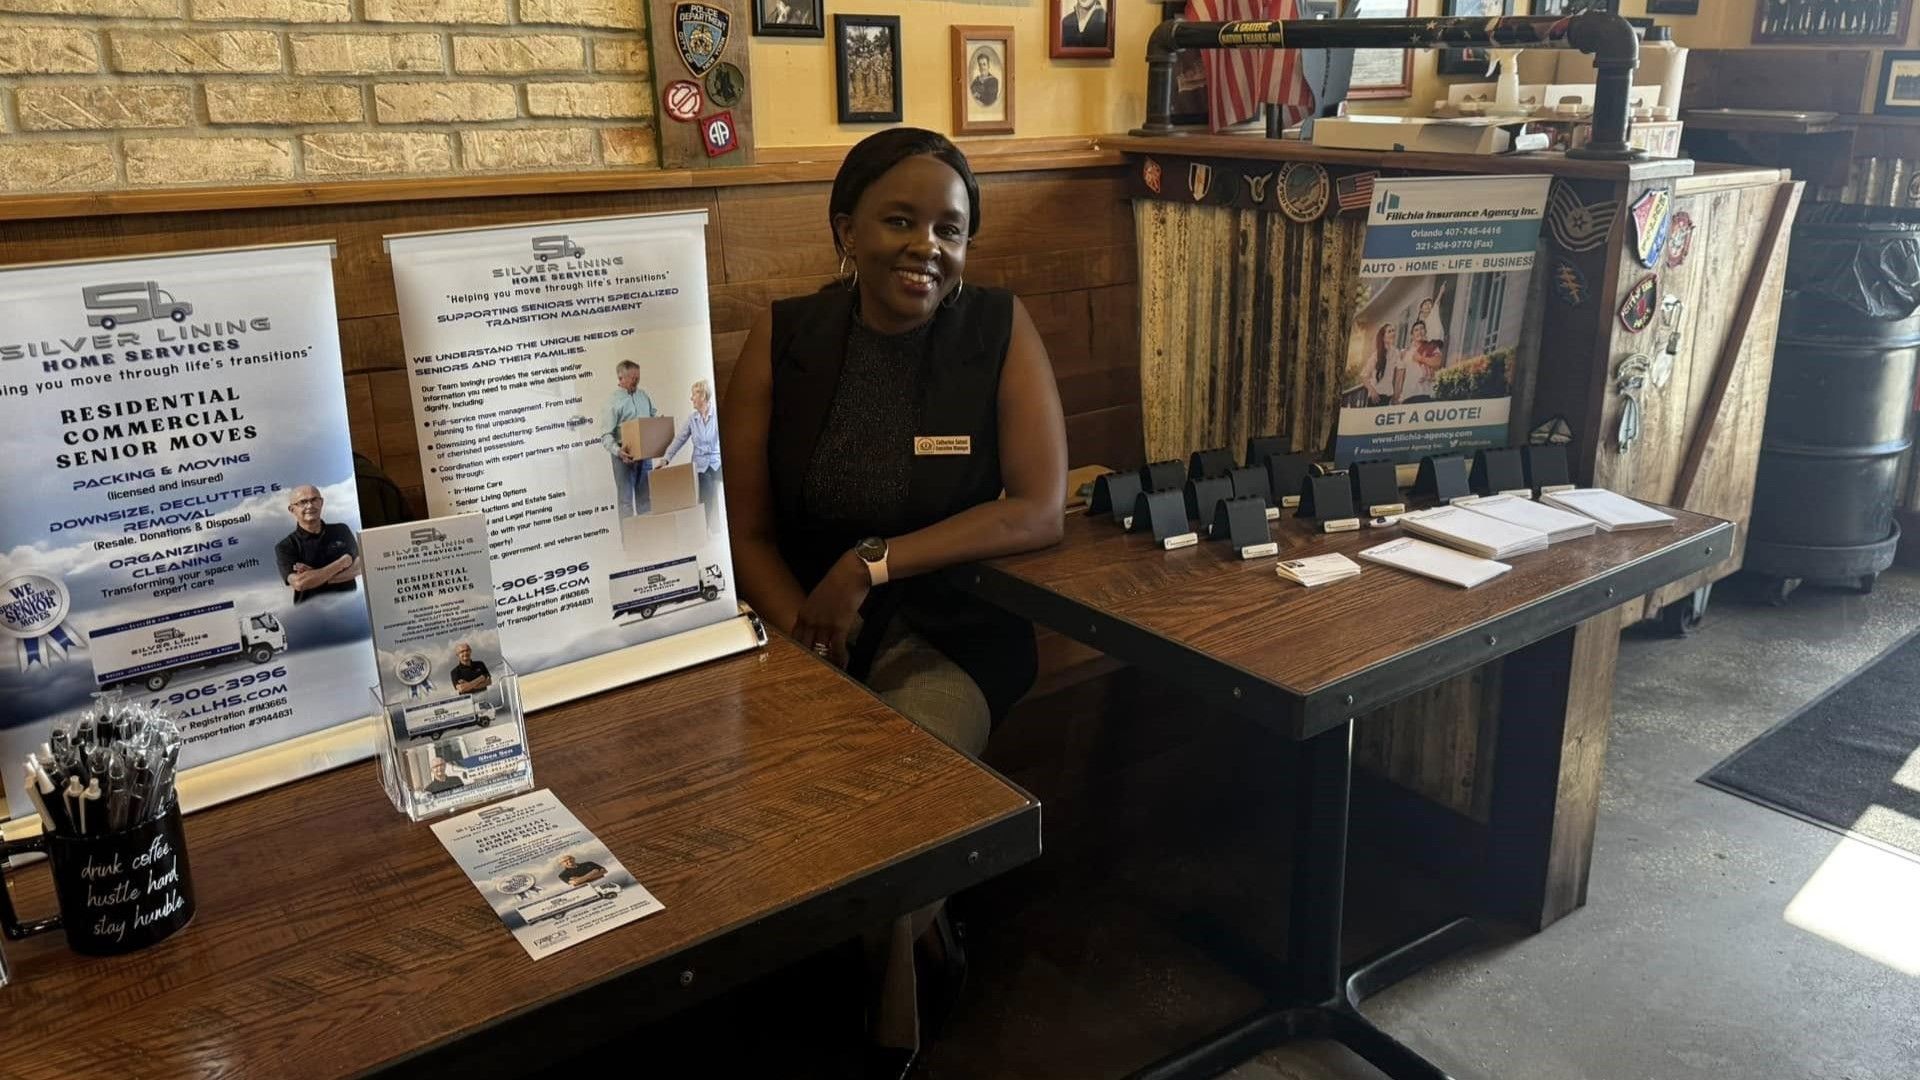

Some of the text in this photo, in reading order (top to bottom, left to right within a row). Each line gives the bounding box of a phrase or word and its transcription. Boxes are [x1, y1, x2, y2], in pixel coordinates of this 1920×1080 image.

[680, 11, 728, 30] DEPARTMENT
[690, 4, 719, 18] POLICE
[1426, 209, 1480, 221] Insurance
[1480, 207, 1520, 220] Agency
[1520, 207, 1539, 216] Inc.
[1410, 228, 1444, 239] Orlando
[492, 255, 625, 278] SILVER LINING
[511, 267, 608, 286] HOME SERVICES
[1362, 256, 1536, 275] AUTO HOME LIFE BUSINESS
[493, 290, 512, 301] you
[514, 286, 542, 296] move
[545, 279, 584, 293] through
[437, 286, 680, 323] SUPPORTING SENIORS WITH SPECIALIZED
[485, 302, 644, 328] TRANSITION MANAGEMENT
[0, 316, 272, 361] SILVER LINING
[413, 327, 636, 365] WE UNDERSTAND THE UNIQUE NEEDS OF
[41, 338, 241, 374] HOME SERVICES
[415, 364, 469, 377] SENIORS
[472, 358, 497, 369] AND
[499, 353, 533, 364] THEIR
[36, 379, 63, 394] you
[70, 373, 113, 387] move
[118, 362, 180, 382] through
[185, 356, 225, 374] life's
[421, 385, 436, 393] Our
[438, 383, 459, 391] Team
[488, 374, 516, 385] provides
[531, 367, 559, 377] services
[467, 389, 480, 398] you
[481, 385, 499, 394] need
[500, 383, 508, 391] to
[509, 381, 528, 391] make
[529, 379, 545, 388] wise
[547, 374, 578, 385] decisions
[579, 371, 594, 380] with
[60, 386, 241, 425] RESIDENTIAL
[1375, 406, 1482, 427] GET A QUOTE!
[63, 407, 245, 446] COMMERCIAL
[56, 424, 258, 470] SENIOR MOVES
[438, 459, 484, 473] Coordination
[485, 455, 501, 466] with
[556, 442, 570, 452] who
[571, 440, 584, 449] can
[72, 452, 251, 492] PACKING & MOVING
[107, 472, 225, 502] (licensed and insured)
[455, 496, 479, 508] Senior
[480, 491, 502, 503] Living
[49, 482, 282, 534] DOWNSIZE, DECLUTTER &
[123, 508, 216, 534] REMOVAL
[139, 525, 193, 543] Donations
[195, 521, 204, 532] &
[206, 512, 252, 530] Disposal)
[108, 536, 240, 570] ORGANIZING &
[131, 553, 223, 579] CLEANING
[101, 557, 260, 599] Transforming your space with
[153, 577, 215, 598] expert care
[396, 566, 468, 586] RESIDENTIAL
[397, 575, 471, 595] COMMERCIAL
[493, 560, 590, 591] -906-3996
[9, 582, 36, 601] WE
[394, 582, 475, 605] SENIOR MOVES
[495, 576, 591, 607] CALLHS.COM
[5, 595, 58, 624] SENIOR
[20, 610, 52, 628] MOVES
[176, 683, 289, 721] ALLHS.COM
[189, 709, 246, 731] Registration
[80, 853, 124, 881] drink
[86, 879, 142, 908] hustle
[93, 911, 127, 943] stay
